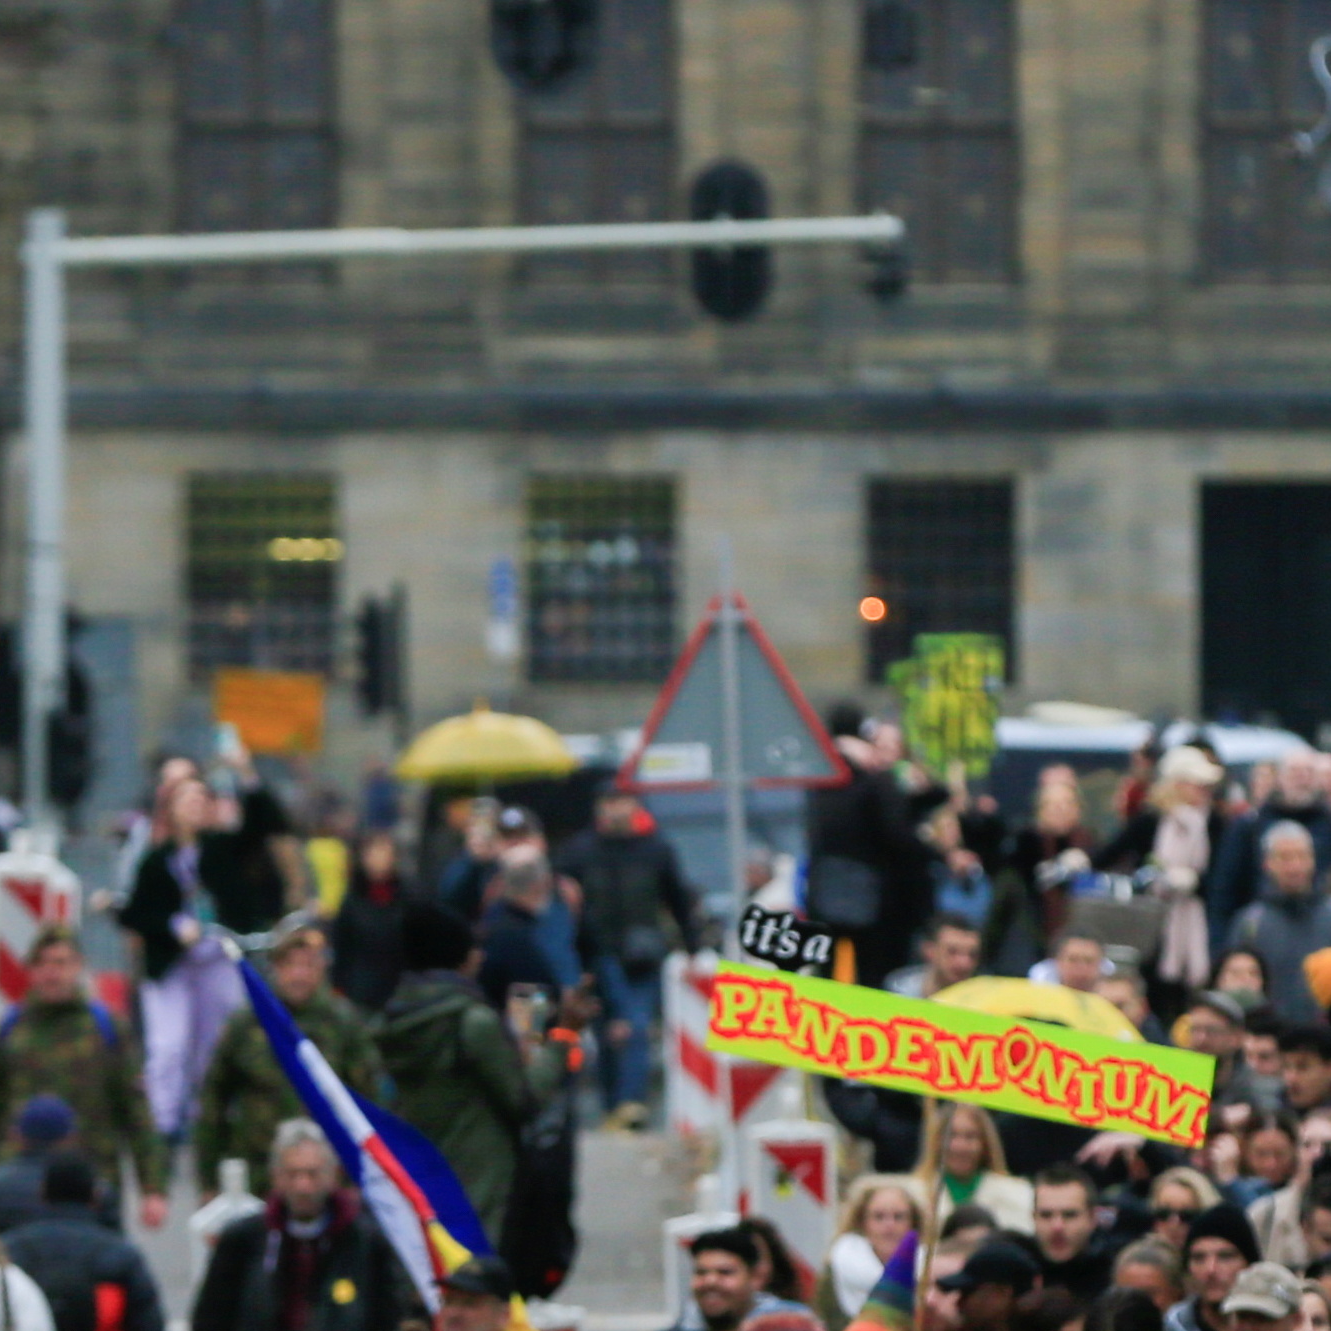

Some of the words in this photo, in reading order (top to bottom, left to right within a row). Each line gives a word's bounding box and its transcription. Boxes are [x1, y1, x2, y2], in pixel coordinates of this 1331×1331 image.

[742, 907, 801, 959] it's
[801, 932, 832, 963] a
[712, 976, 1208, 1144] PANDEMONIUM
